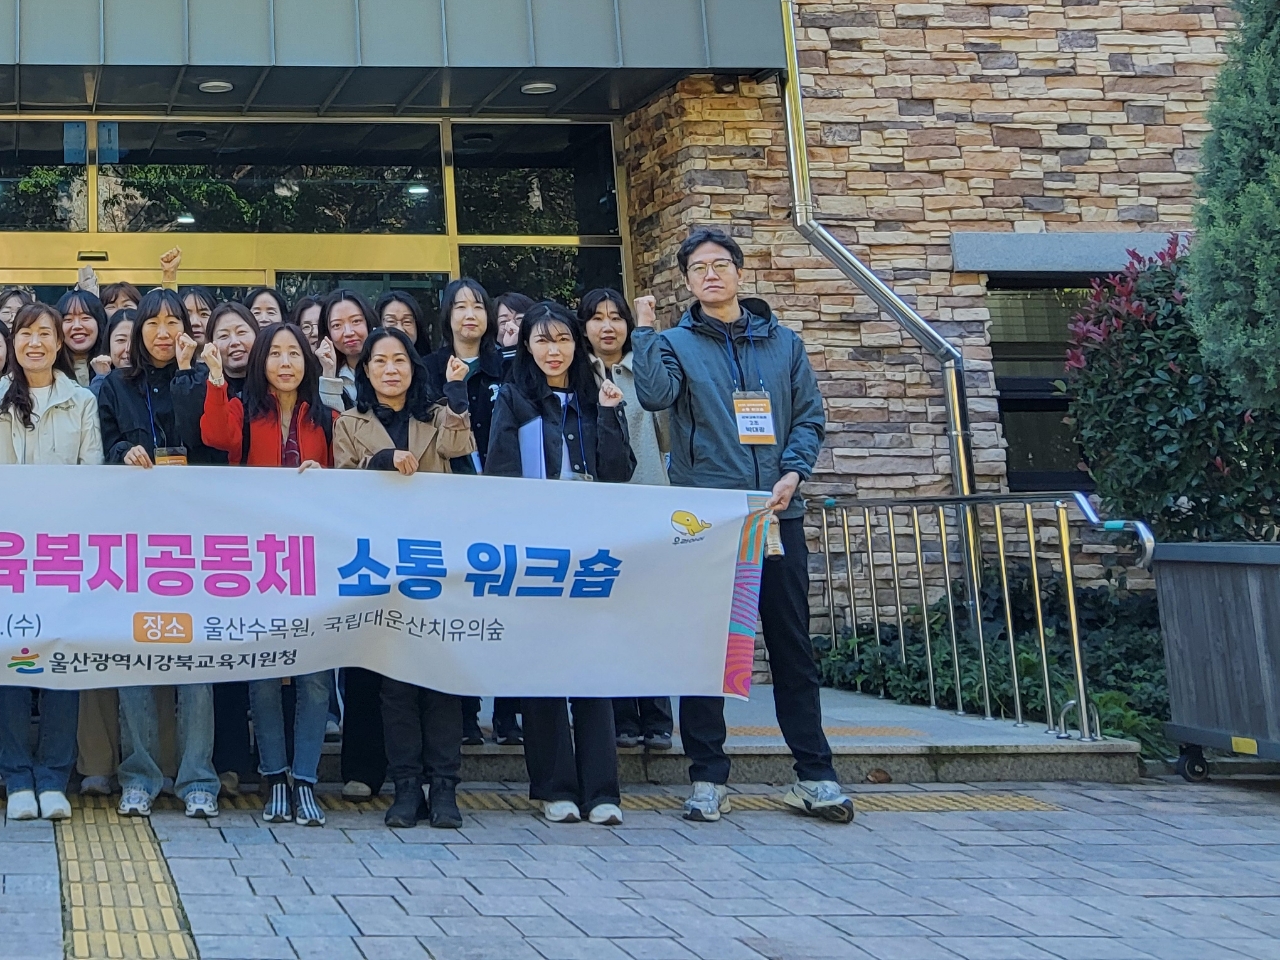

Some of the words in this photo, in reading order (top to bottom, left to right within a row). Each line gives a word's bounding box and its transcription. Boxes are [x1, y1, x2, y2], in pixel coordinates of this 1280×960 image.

[337, 538, 448, 600] 소통
[464, 542, 623, 598] 워크숍
[143, 615, 186, 640] 장소
[204, 616, 316, 642] 울산수목원,
[323, 609, 505, 642] 국립대운산치유의숲
[49, 649, 298, 674] 울산광역시강북교육지원청
